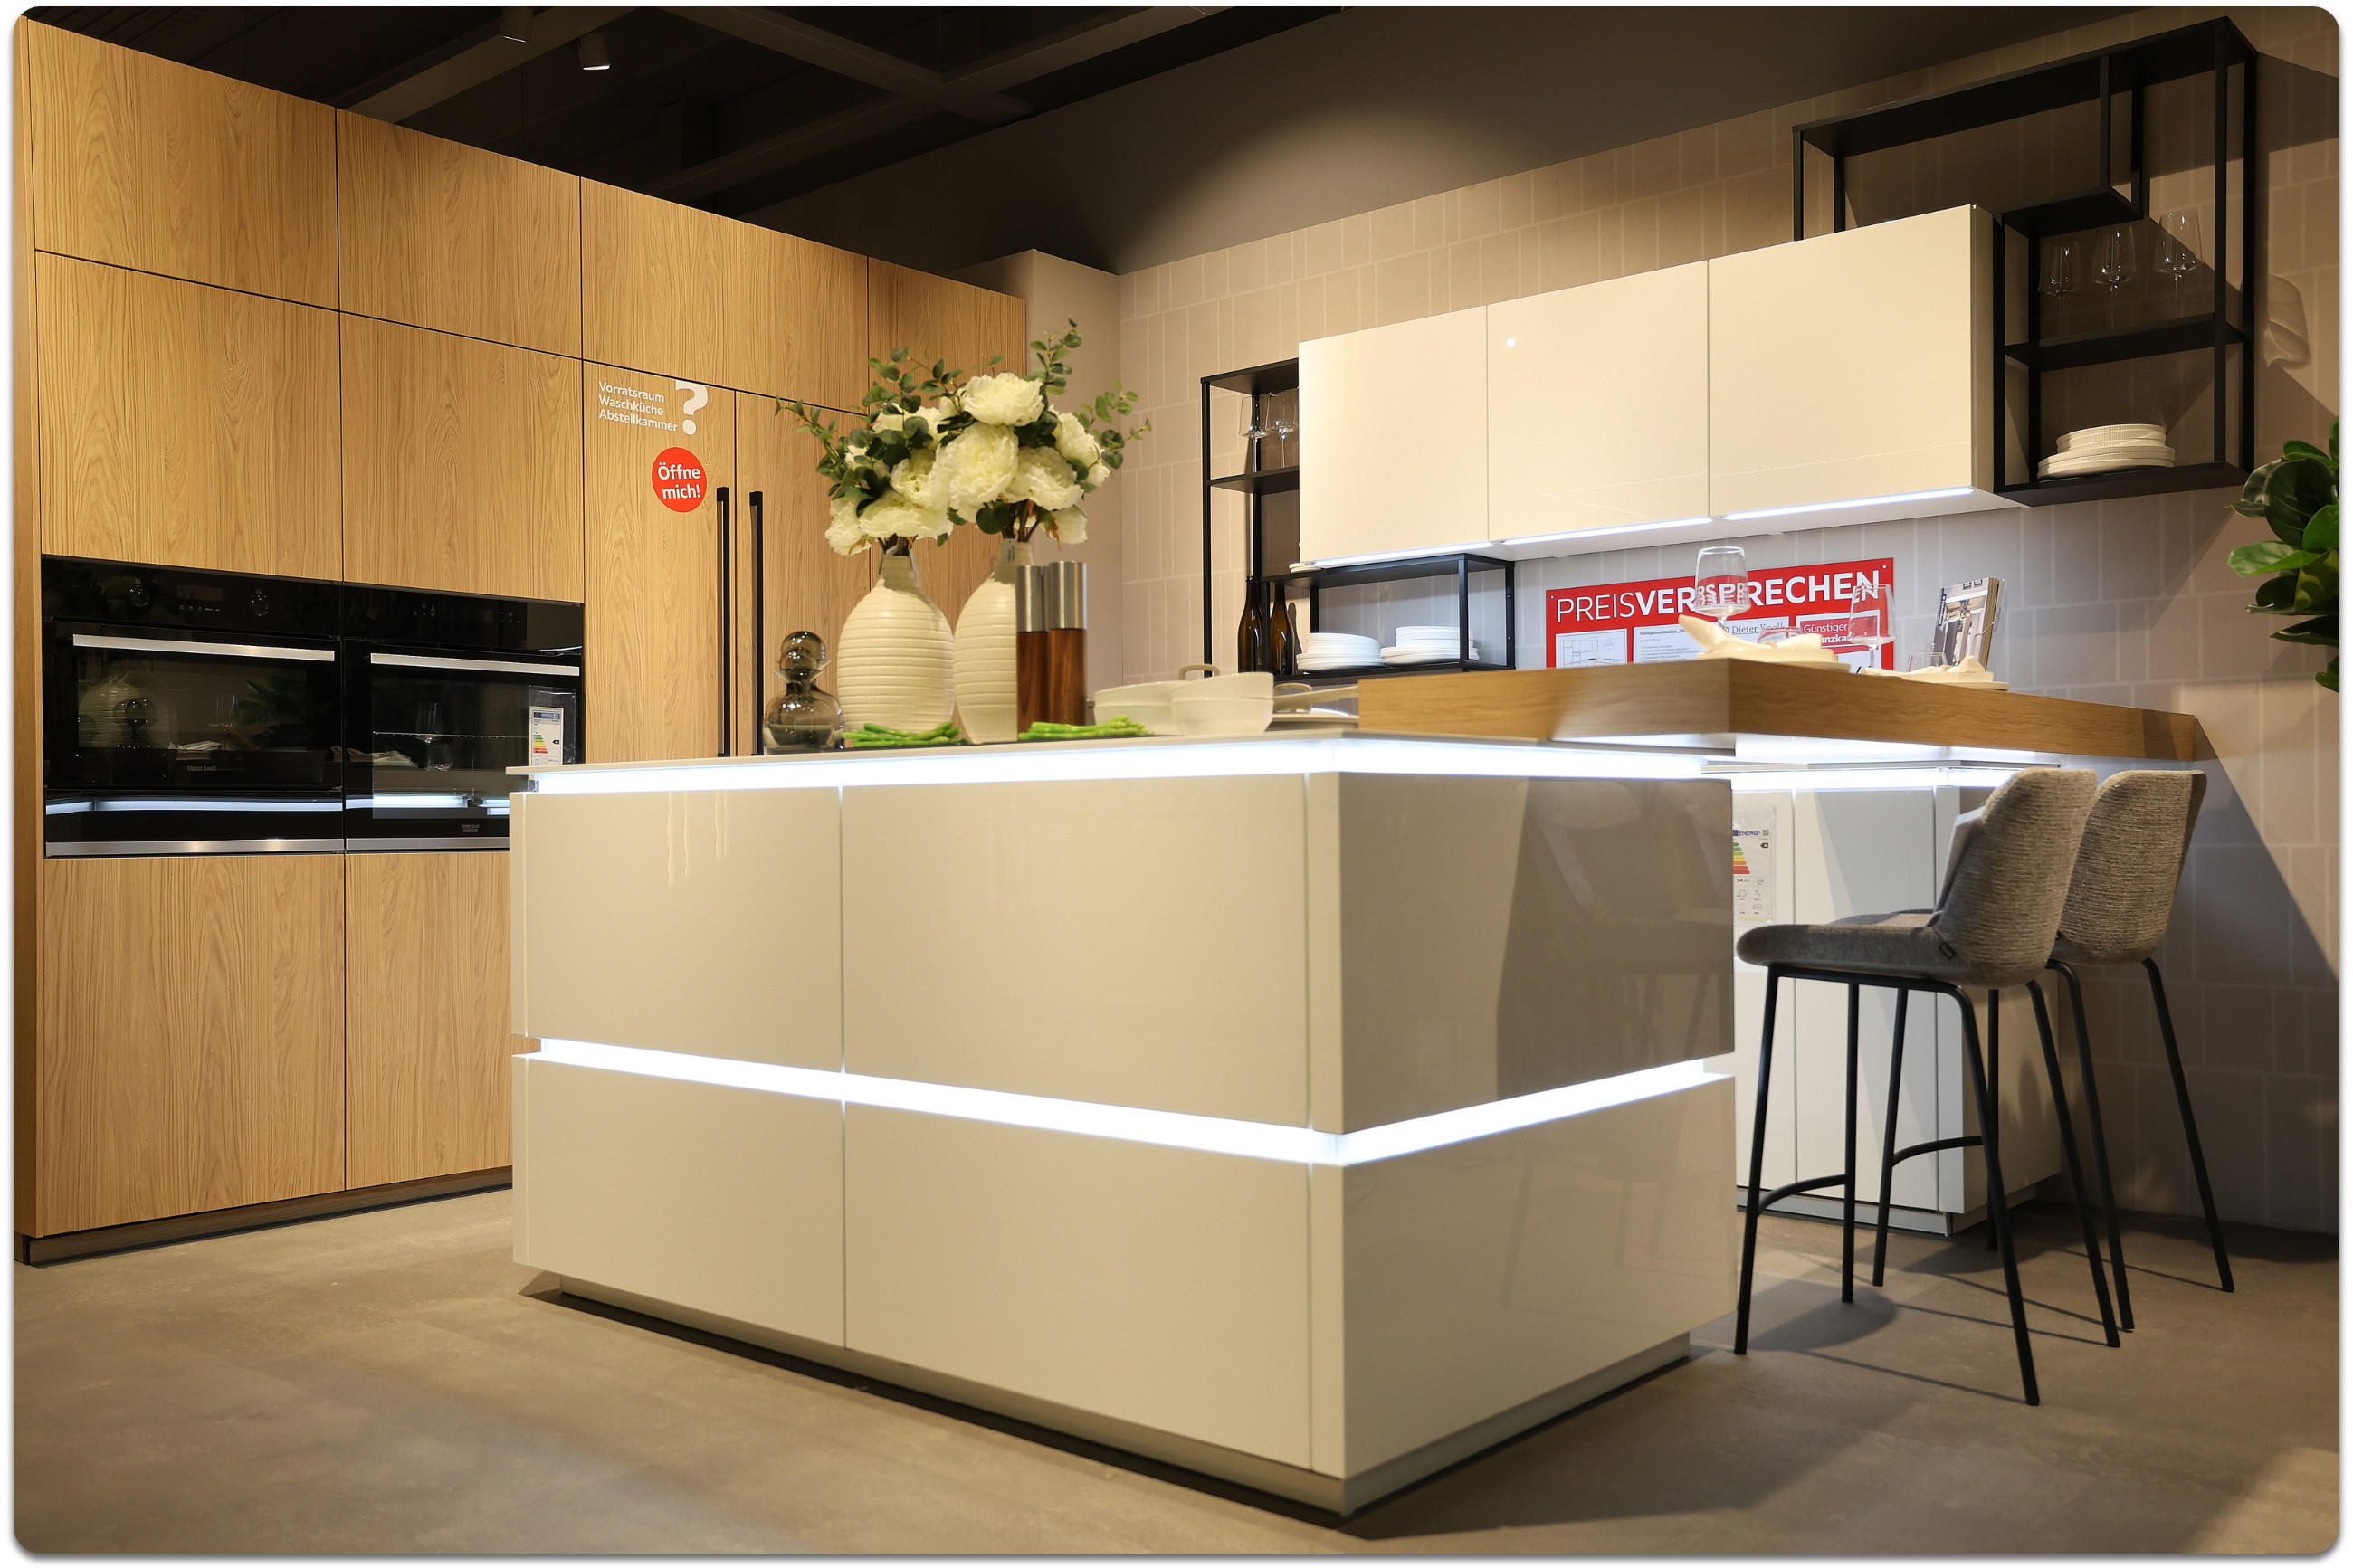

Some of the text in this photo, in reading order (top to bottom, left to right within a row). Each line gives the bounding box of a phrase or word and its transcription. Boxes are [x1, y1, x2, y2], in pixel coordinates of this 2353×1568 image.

[598, 380, 665, 403] Vorratsraum
[598, 394, 664, 416] Waschküche
[675, 379, 709, 435] ?
[598, 408, 679, 432] Abstellkammer
[657, 461, 700, 480] Öffne
[662, 484, 701, 499] mich!
[1731, 624, 1758, 633] Dieter
[1803, 622, 1848, 633] Günstiger
